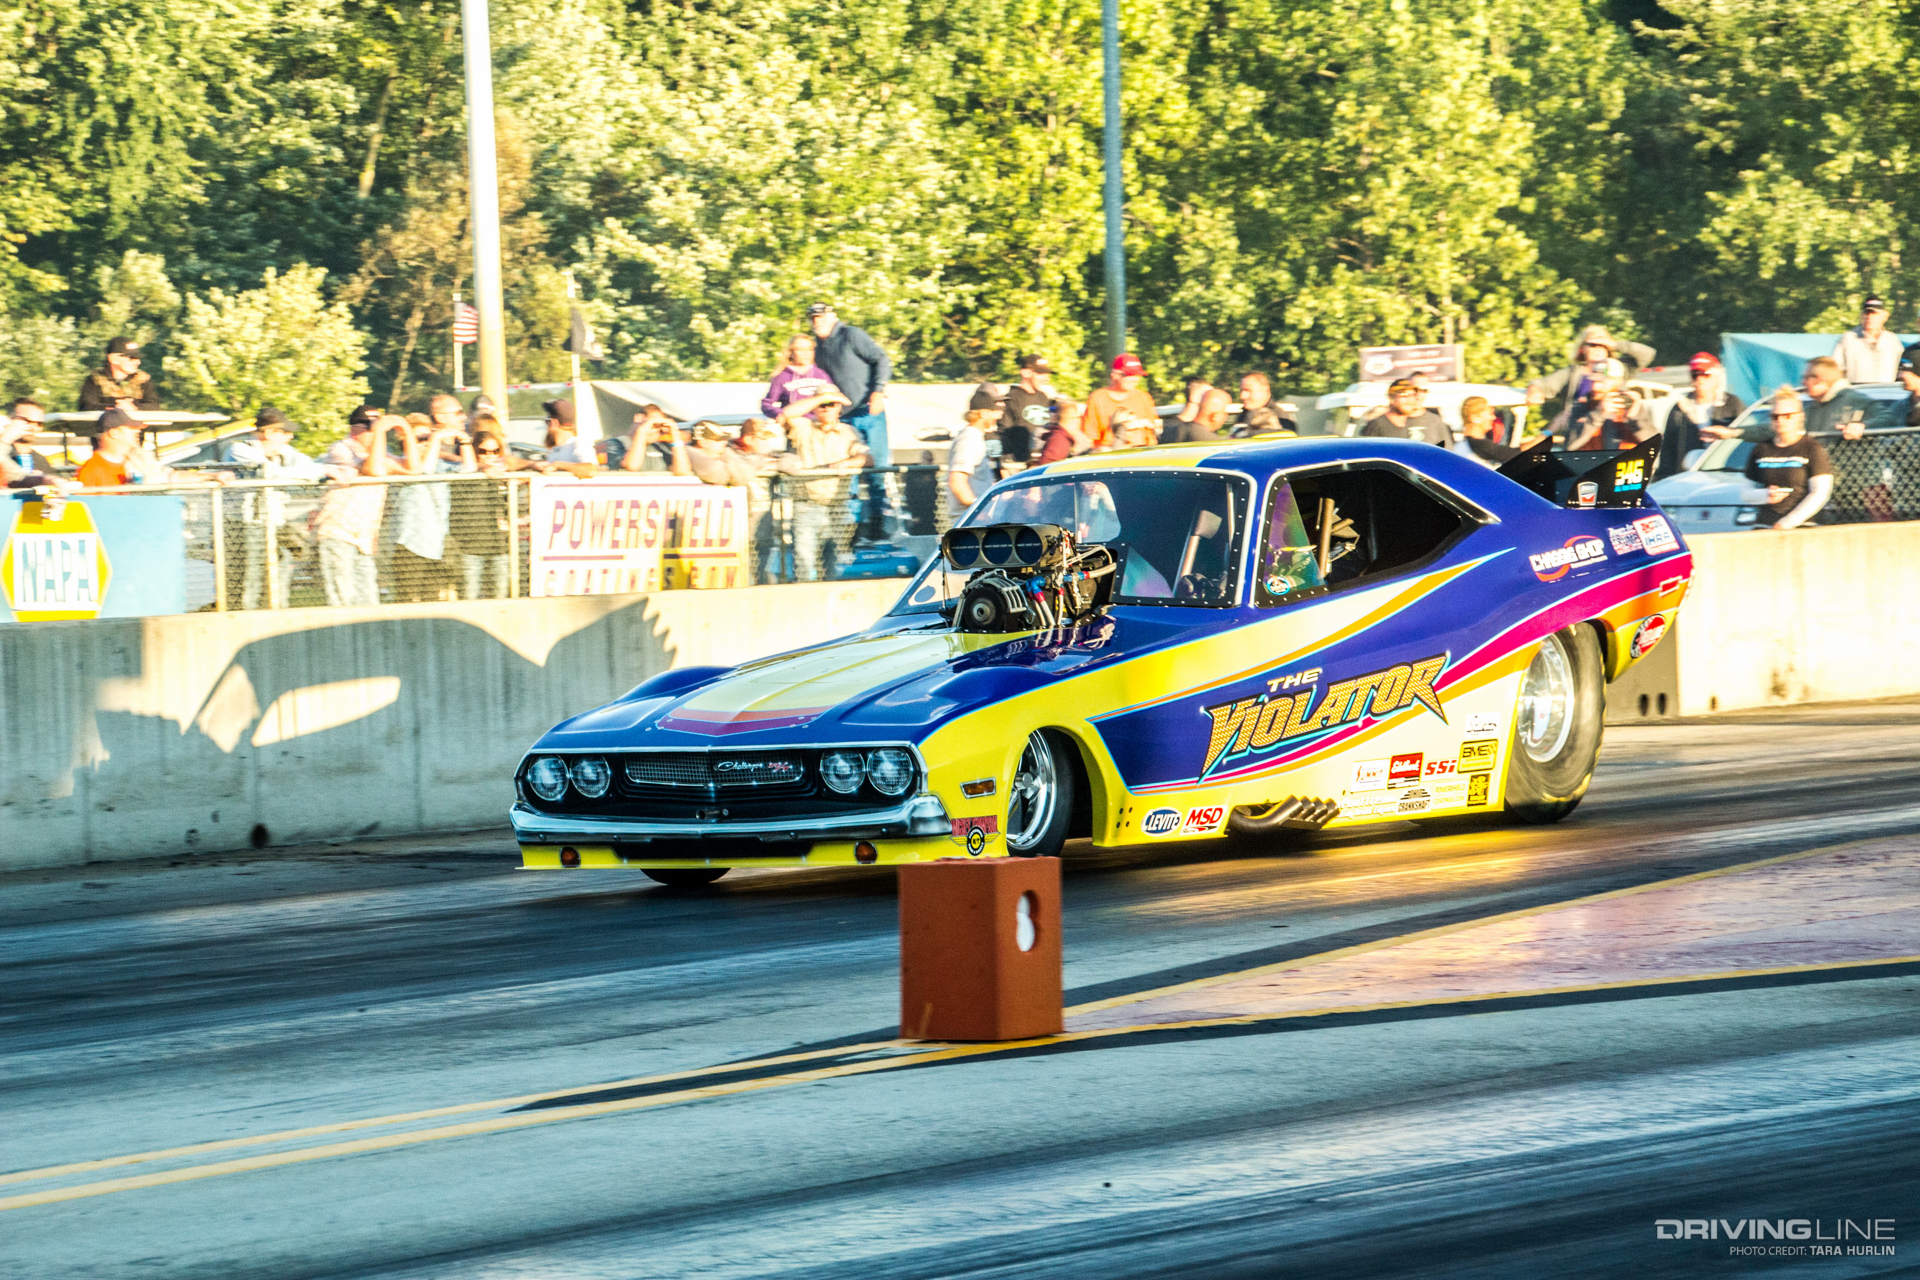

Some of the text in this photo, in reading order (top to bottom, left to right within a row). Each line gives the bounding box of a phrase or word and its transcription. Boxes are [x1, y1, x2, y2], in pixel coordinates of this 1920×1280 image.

[549, 499, 733, 550] POWERSHIELD
[1575, 538, 1605, 560] SHOP
[1644, 531, 1671, 546] IHRA
[21, 539, 93, 602] NAPA
[1267, 668, 1323, 693] THE
[1462, 744, 1489, 758] BME
[1142, 812, 1180, 832] CLEVITE
[1185, 807, 1224, 827] MSD
